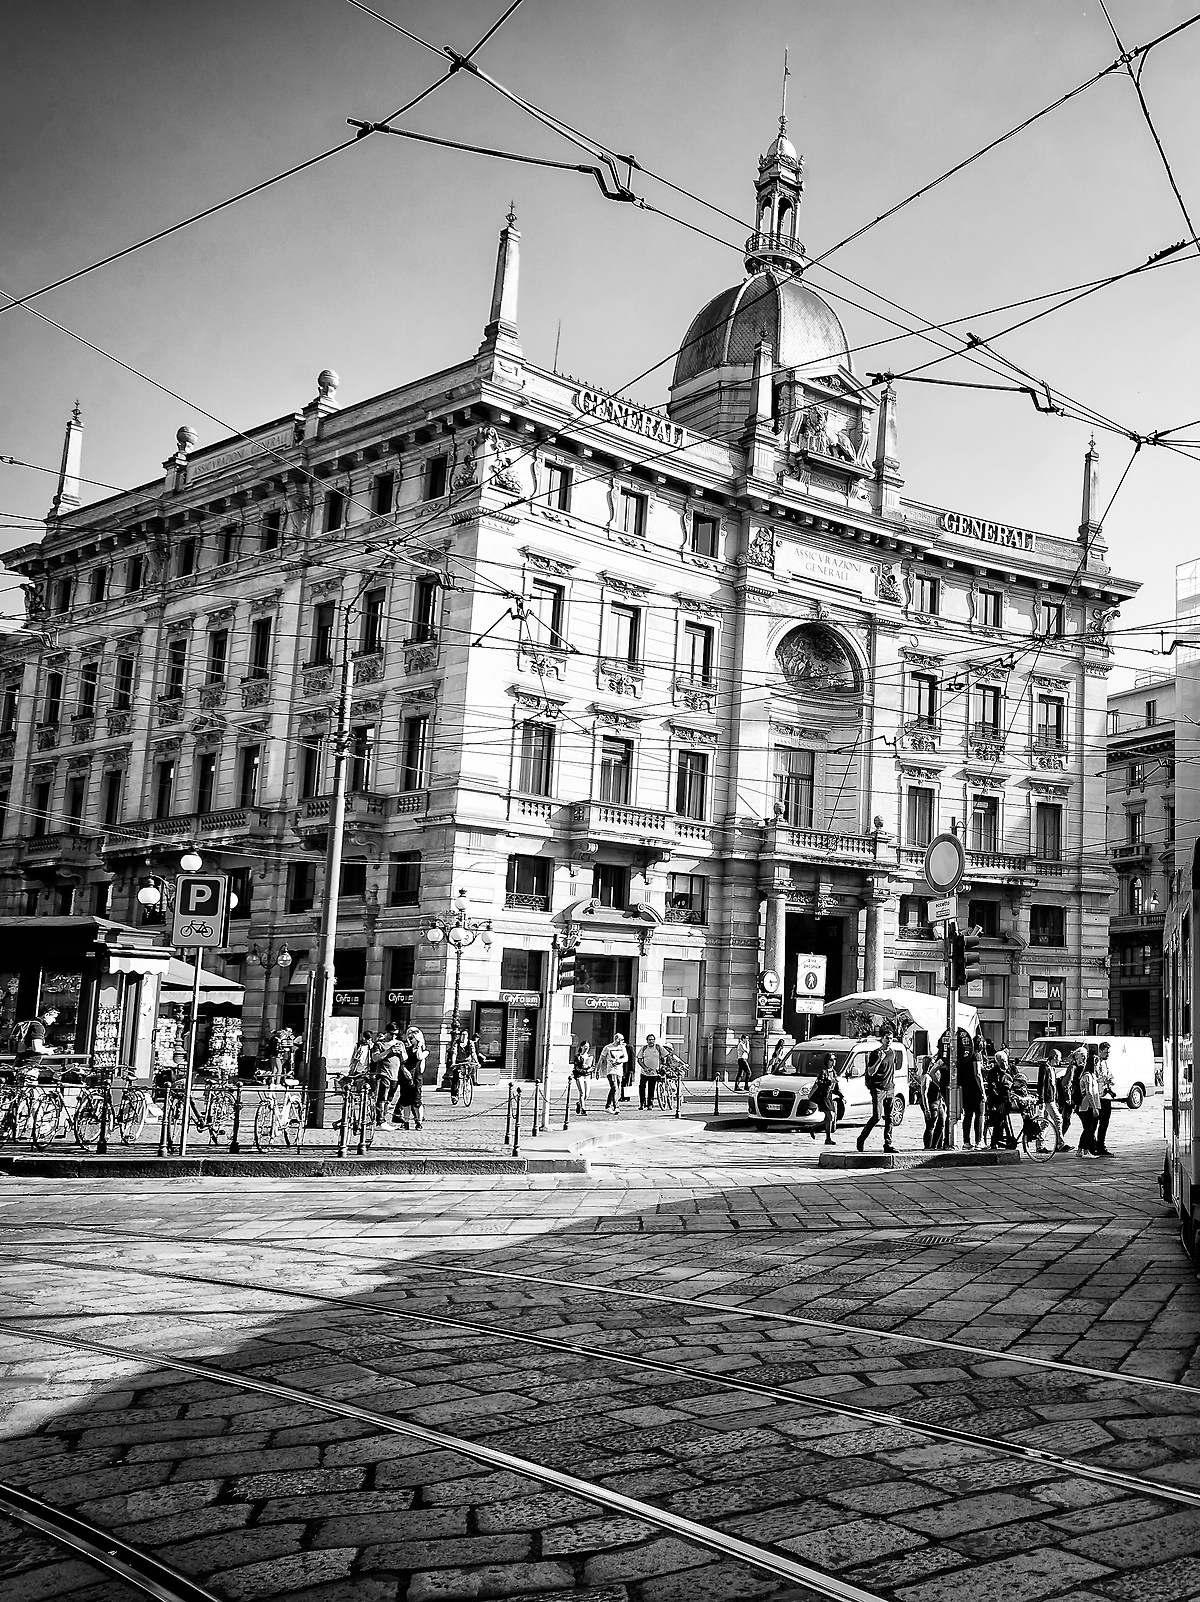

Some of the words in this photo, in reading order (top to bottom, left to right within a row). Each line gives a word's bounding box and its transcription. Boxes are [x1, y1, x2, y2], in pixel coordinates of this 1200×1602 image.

[578, 389, 687, 447] GENERALI
[943, 511, 1036, 552] GENERALI
[805, 562, 849, 580] GENERALI
[188, 884, 212, 911] P
[1050, 986, 1061, 998] M
